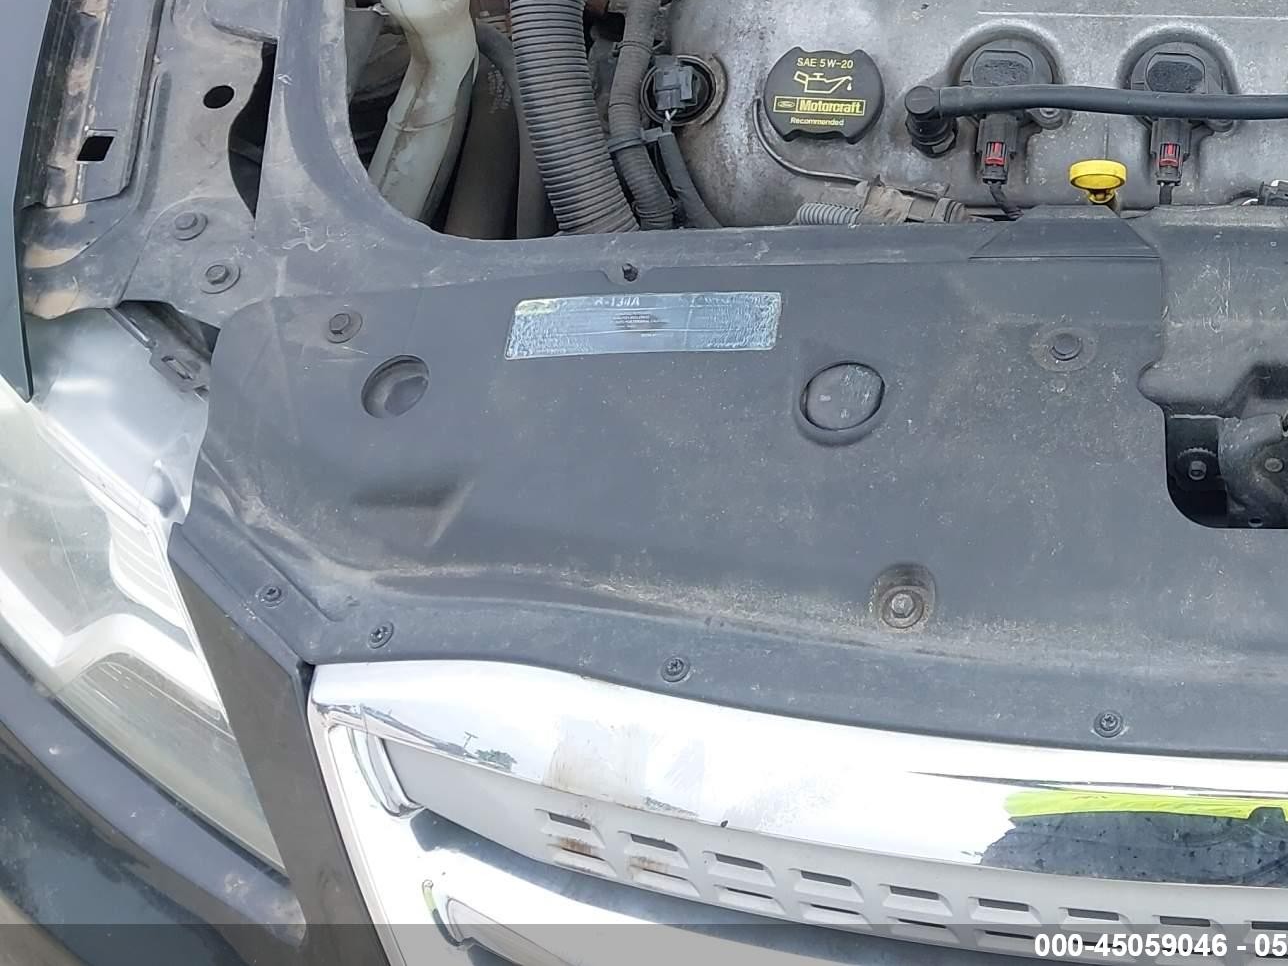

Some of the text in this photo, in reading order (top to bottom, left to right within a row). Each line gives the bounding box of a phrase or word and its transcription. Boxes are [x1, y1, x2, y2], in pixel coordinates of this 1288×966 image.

[796, 57, 817, 68] SAE
[799, 99, 863, 114] Motorcraft
[790, 116, 844, 126] Recommended
